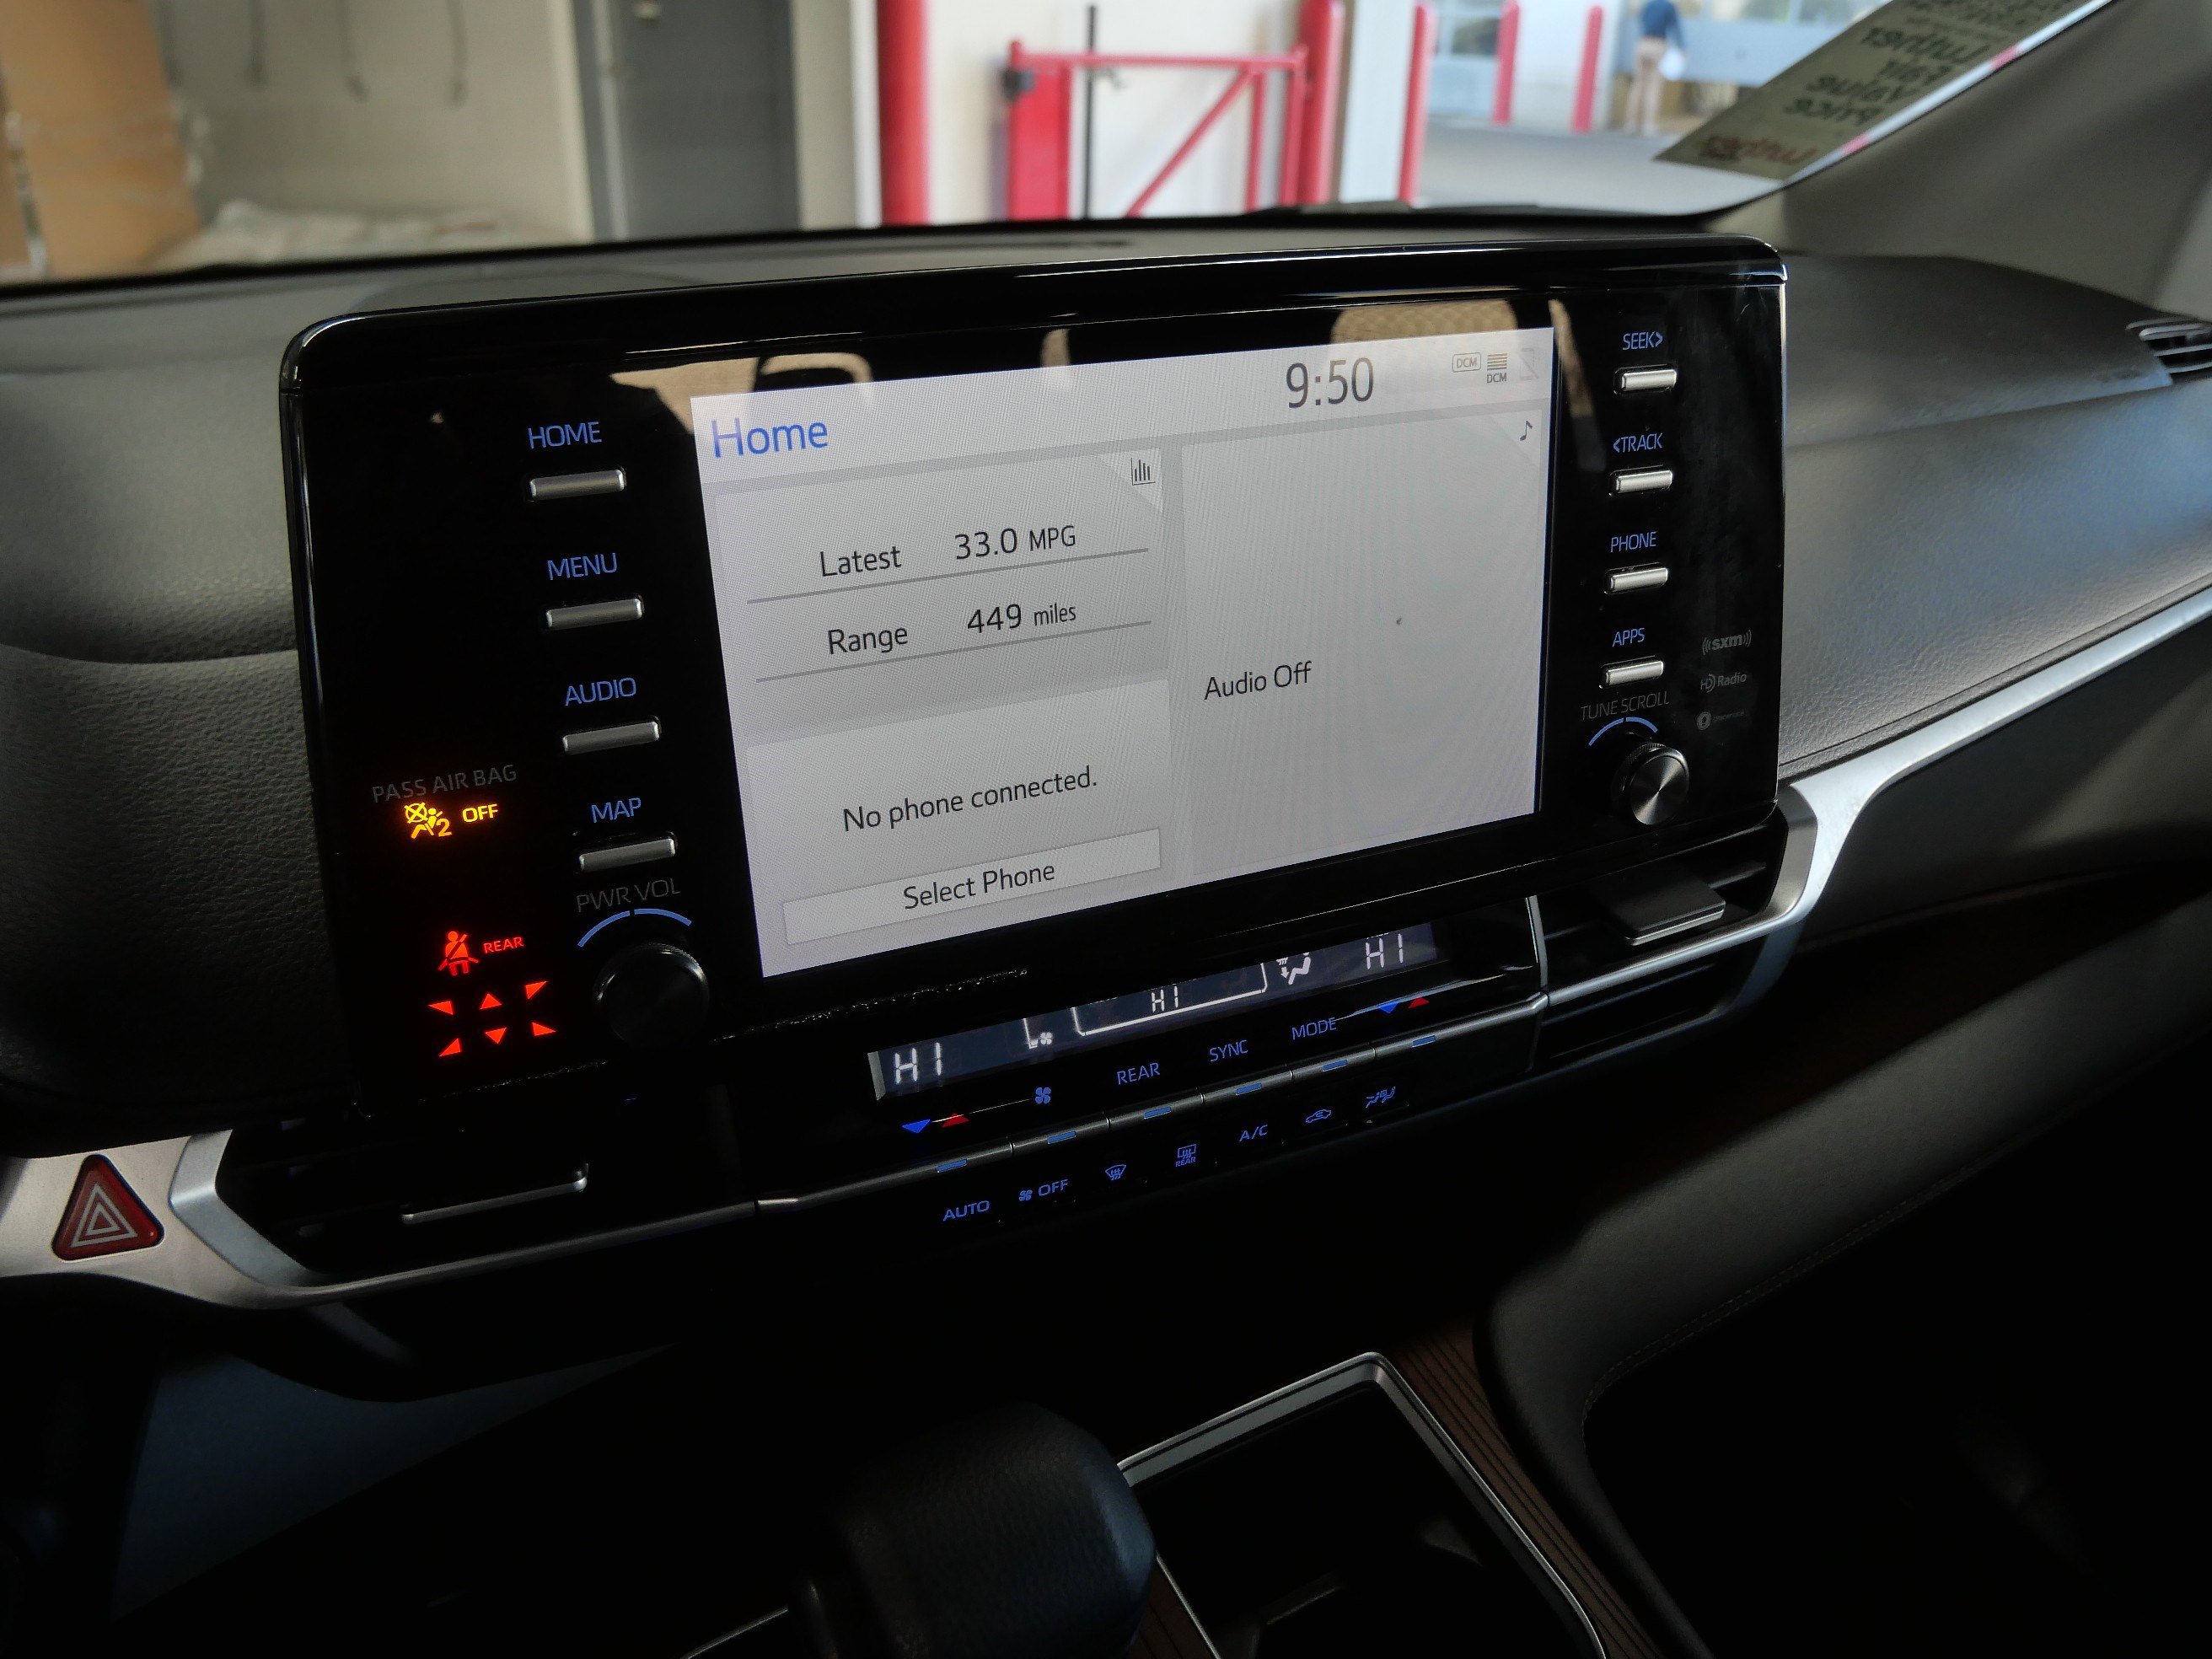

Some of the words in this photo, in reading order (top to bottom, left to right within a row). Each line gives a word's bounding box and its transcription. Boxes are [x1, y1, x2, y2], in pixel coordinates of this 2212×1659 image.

[1456, 357, 1478, 368] DCM
[1286, 357, 1373, 408] 9:50
[1487, 373, 1506, 384] DCM
[528, 421, 602, 448] HOME
[711, 417, 829, 458] Home
[820, 546, 901, 577] Latest
[955, 529, 1017, 560] 33.0
[1029, 525, 1076, 551] MPG
[1611, 531, 1656, 552] PHONE
[547, 553, 617, 580] MENU
[828, 628, 907, 654] Range
[968, 604, 1021, 633] 449
[1034, 603, 1076, 625] miles
[1613, 627, 1645, 647] APPS
[1205, 672, 1266, 700] Audio
[1274, 661, 1312, 687] Off
[1717, 673, 1747, 686] Radio
[566, 678, 636, 706] AUDIO
[1581, 701, 1619, 721] TUNE
[1621, 691, 1669, 713] SCROLL
[372, 779, 427, 803] PASS
[432, 773, 469, 795] AIR
[473, 765, 516, 787] BAG
[591, 797, 641, 823] MAP
[844, 807, 881, 831] No
[889, 796, 963, 829] phone
[971, 765, 1097, 808] connected.
[462, 804, 498, 822] OFF
[577, 886, 631, 911] PWR
[634, 878, 680, 900] VOL
[904, 878, 975, 910] Select
[983, 866, 1054, 893] Phone
[483, 937, 523, 953] REAR
[1291, 1017, 1337, 1039] MODE
[1210, 1039, 1248, 1061] SYNC
[1117, 1062, 1160, 1084] REAR
[1239, 1125, 1267, 1141] A/C
[1175, 1157, 1196, 1168] REAR
[1038, 1179, 1067, 1196] OFF
[943, 1200, 990, 1221] AUTO
